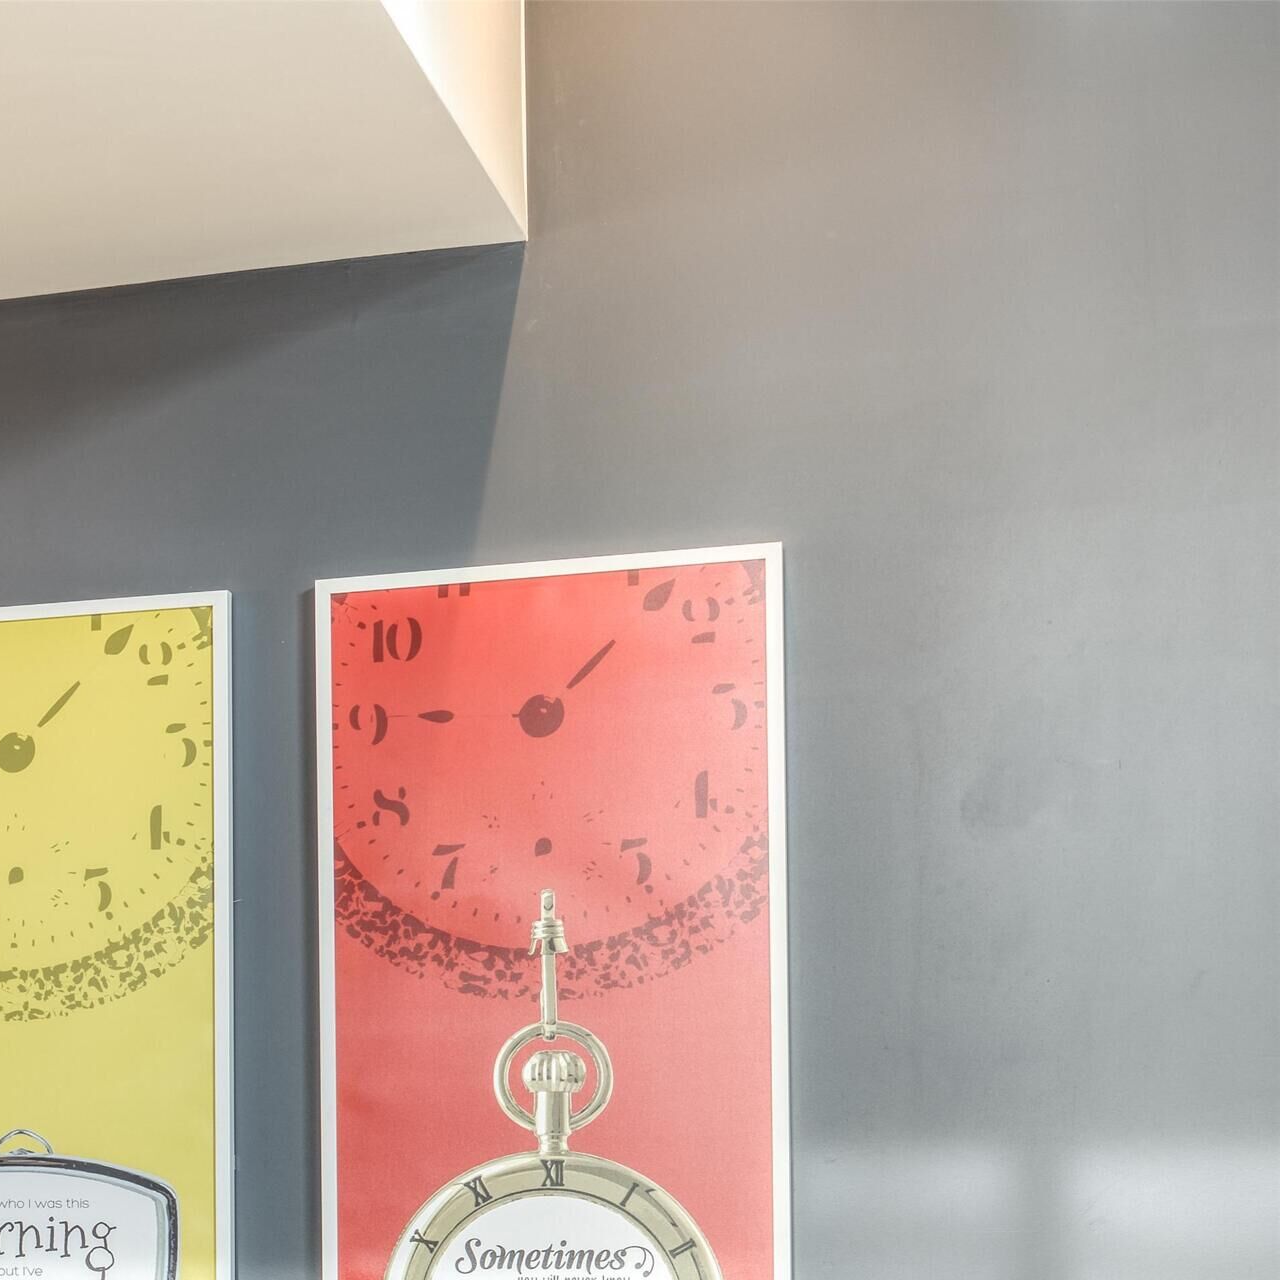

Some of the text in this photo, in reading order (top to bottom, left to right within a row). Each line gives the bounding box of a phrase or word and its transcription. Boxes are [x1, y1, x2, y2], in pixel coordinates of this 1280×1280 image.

[540, 1159, 565, 1187] XII
[35, 1200, 63, 1209] was
[66, 1199, 90, 1209] this
[409, 1229, 440, 1254] X
[455, 1238, 655, 1278] Sometimes
[22, 1266, 43, 1277] I've
